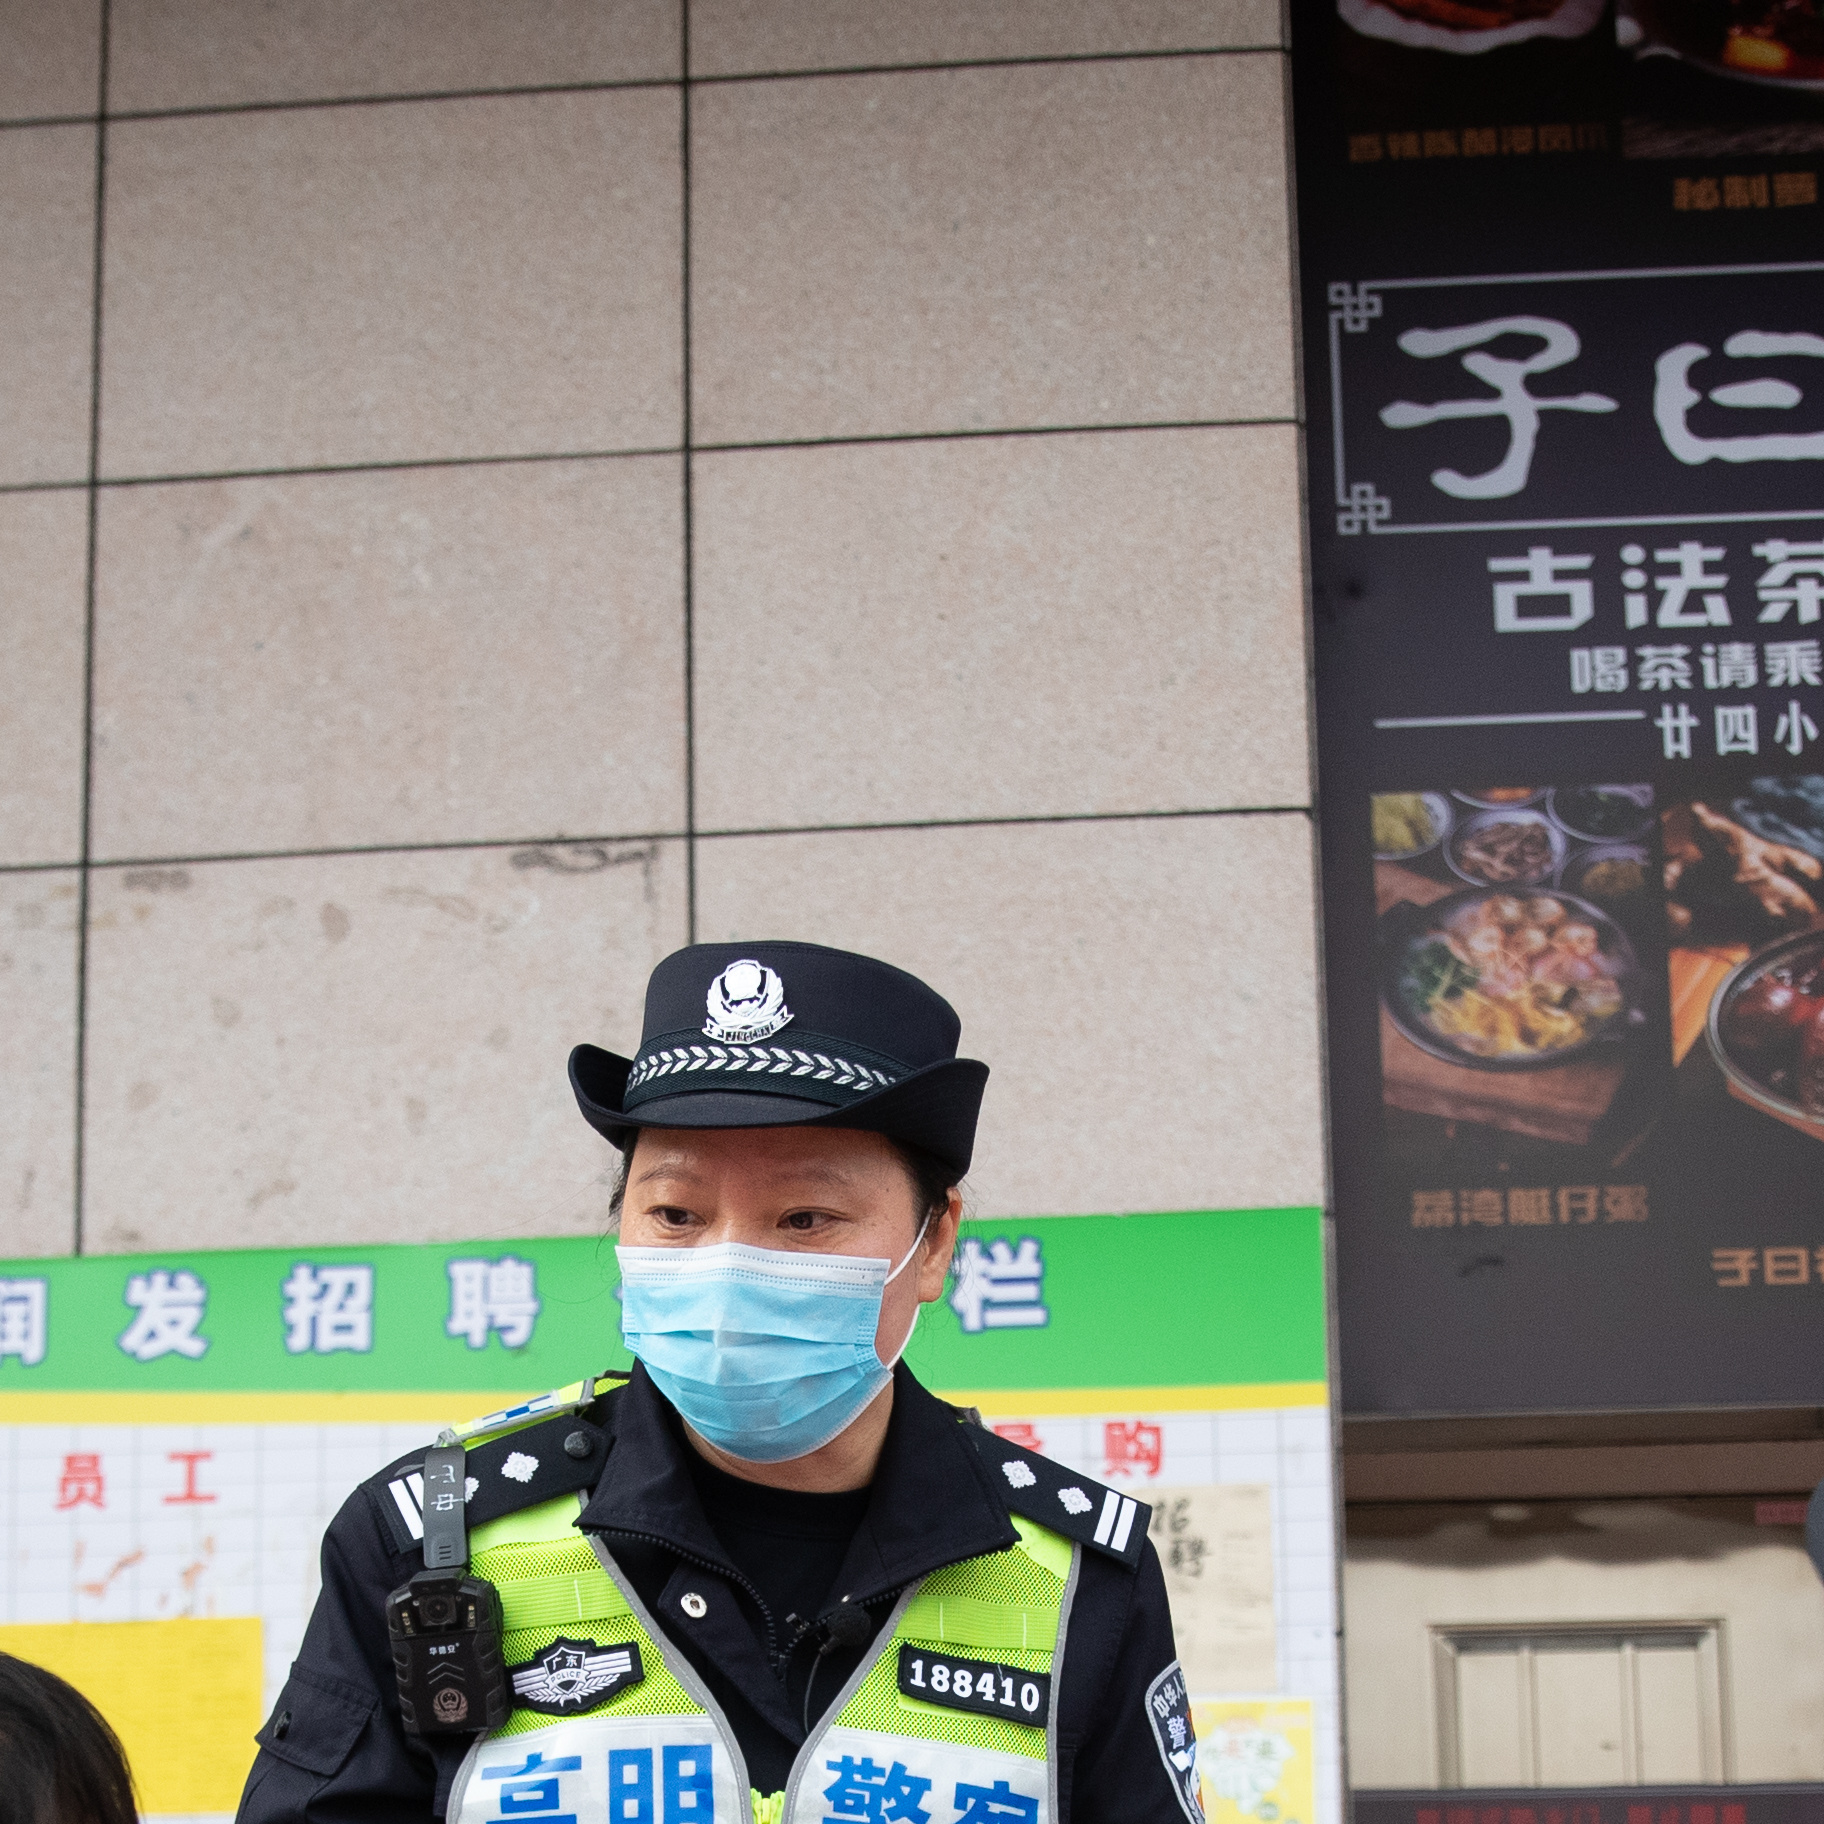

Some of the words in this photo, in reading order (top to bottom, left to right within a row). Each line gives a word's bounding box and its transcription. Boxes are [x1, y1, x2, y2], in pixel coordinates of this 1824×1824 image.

[551, 1654, 578, 1671] 广东
[550, 1670, 582, 1684] POLICE
[909, 1658, 1040, 1713] 188410
